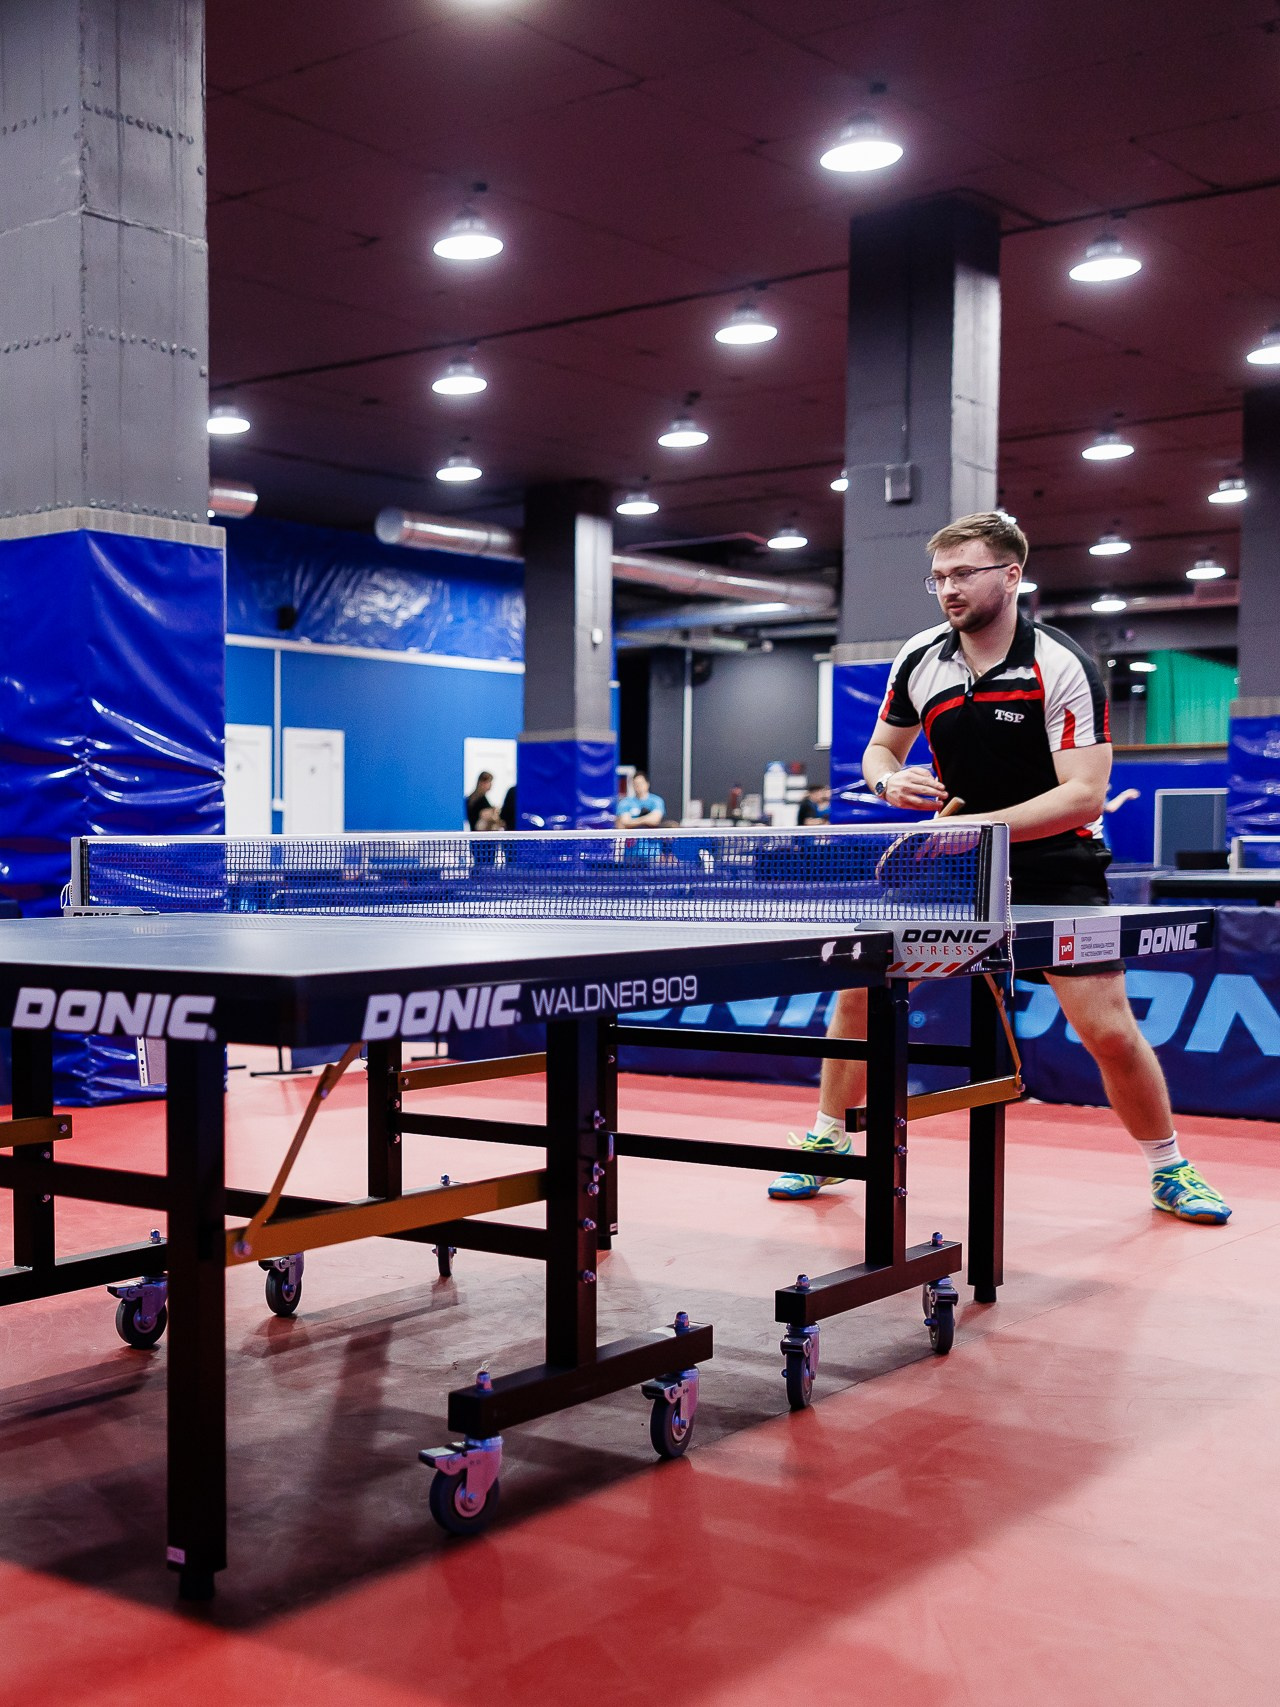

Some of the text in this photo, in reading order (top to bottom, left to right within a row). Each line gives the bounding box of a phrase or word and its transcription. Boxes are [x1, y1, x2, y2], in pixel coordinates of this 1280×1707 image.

[994, 708, 1025, 724] TSP
[901, 929, 991, 944] DONIC
[1137, 924, 1198, 956] DONIC
[11, 986, 217, 1042] DONIC
[361, 983, 522, 1041] DONIC
[531, 979, 648, 1017] WALDNER
[652, 974, 698, 1005] 909
